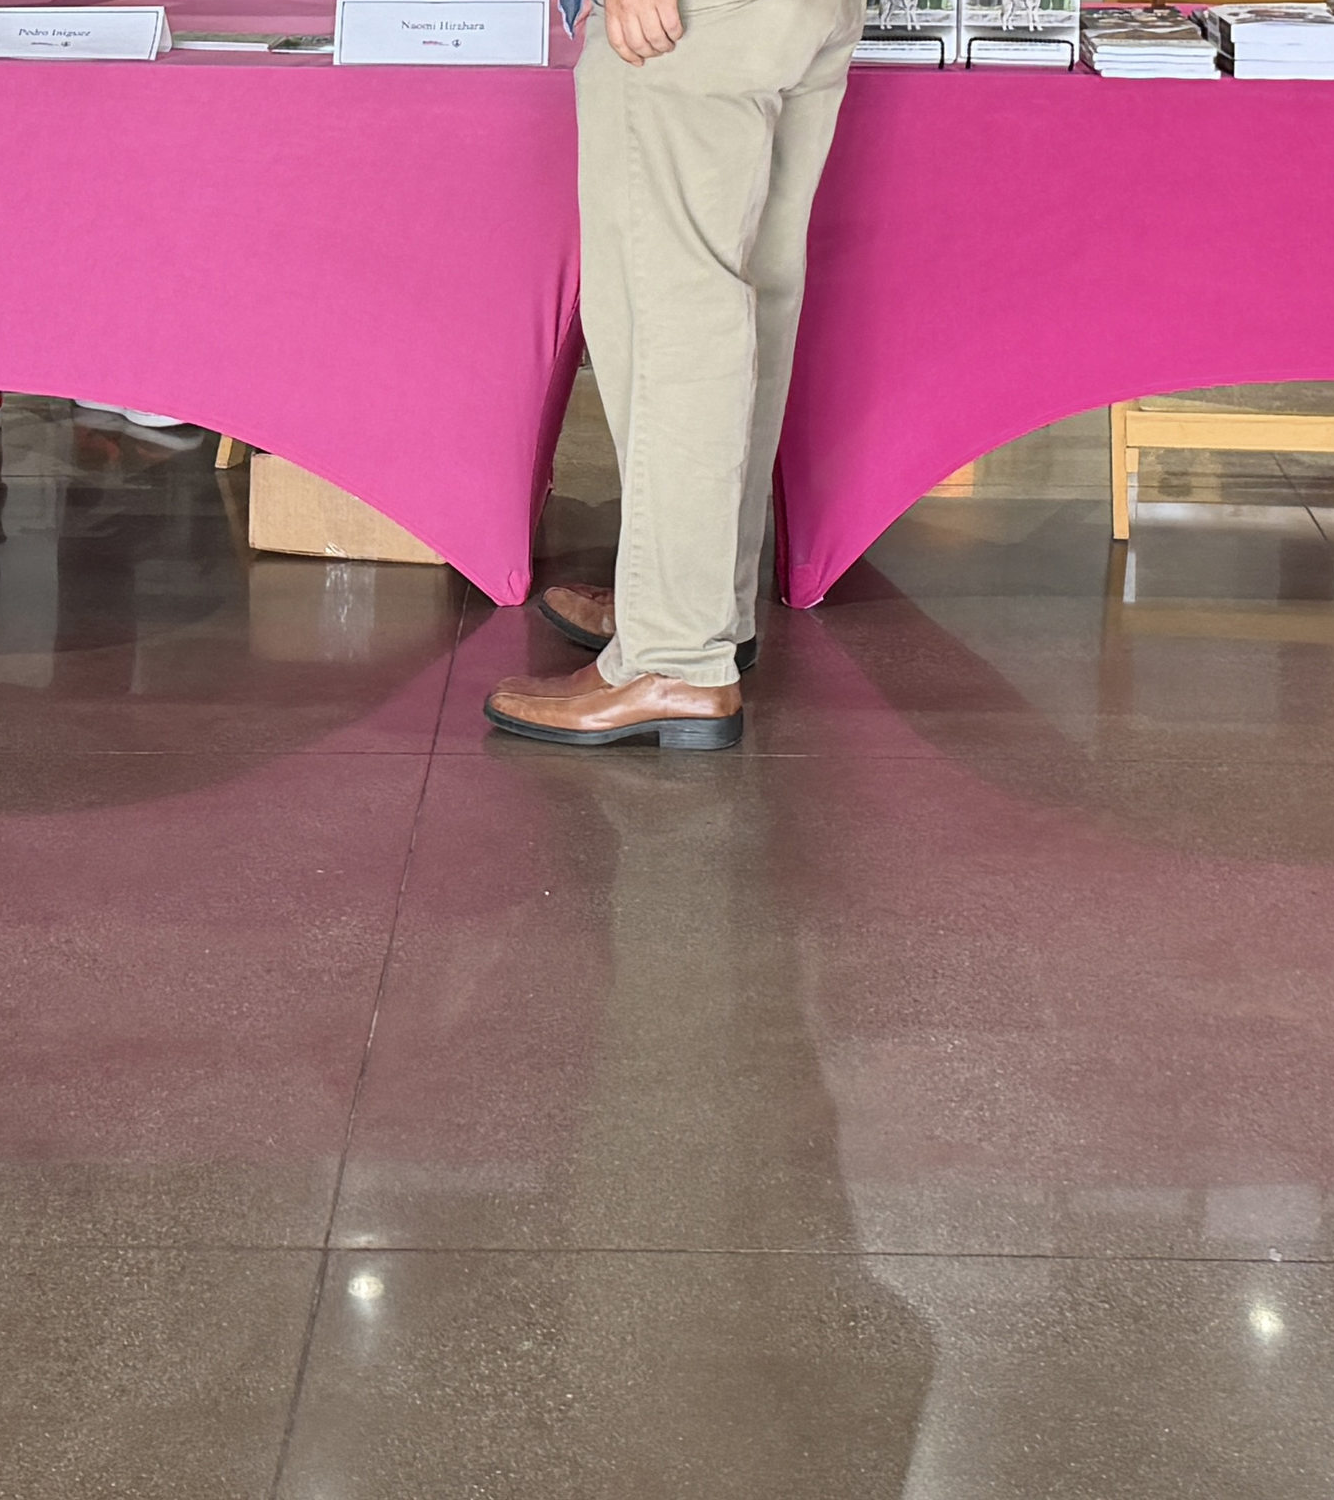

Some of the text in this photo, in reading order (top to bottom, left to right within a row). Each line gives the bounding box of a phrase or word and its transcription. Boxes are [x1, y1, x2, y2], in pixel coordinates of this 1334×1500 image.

[401, 19, 485, 31] Naomi Hirahara
[18, 27, 48, 37] Pedro
